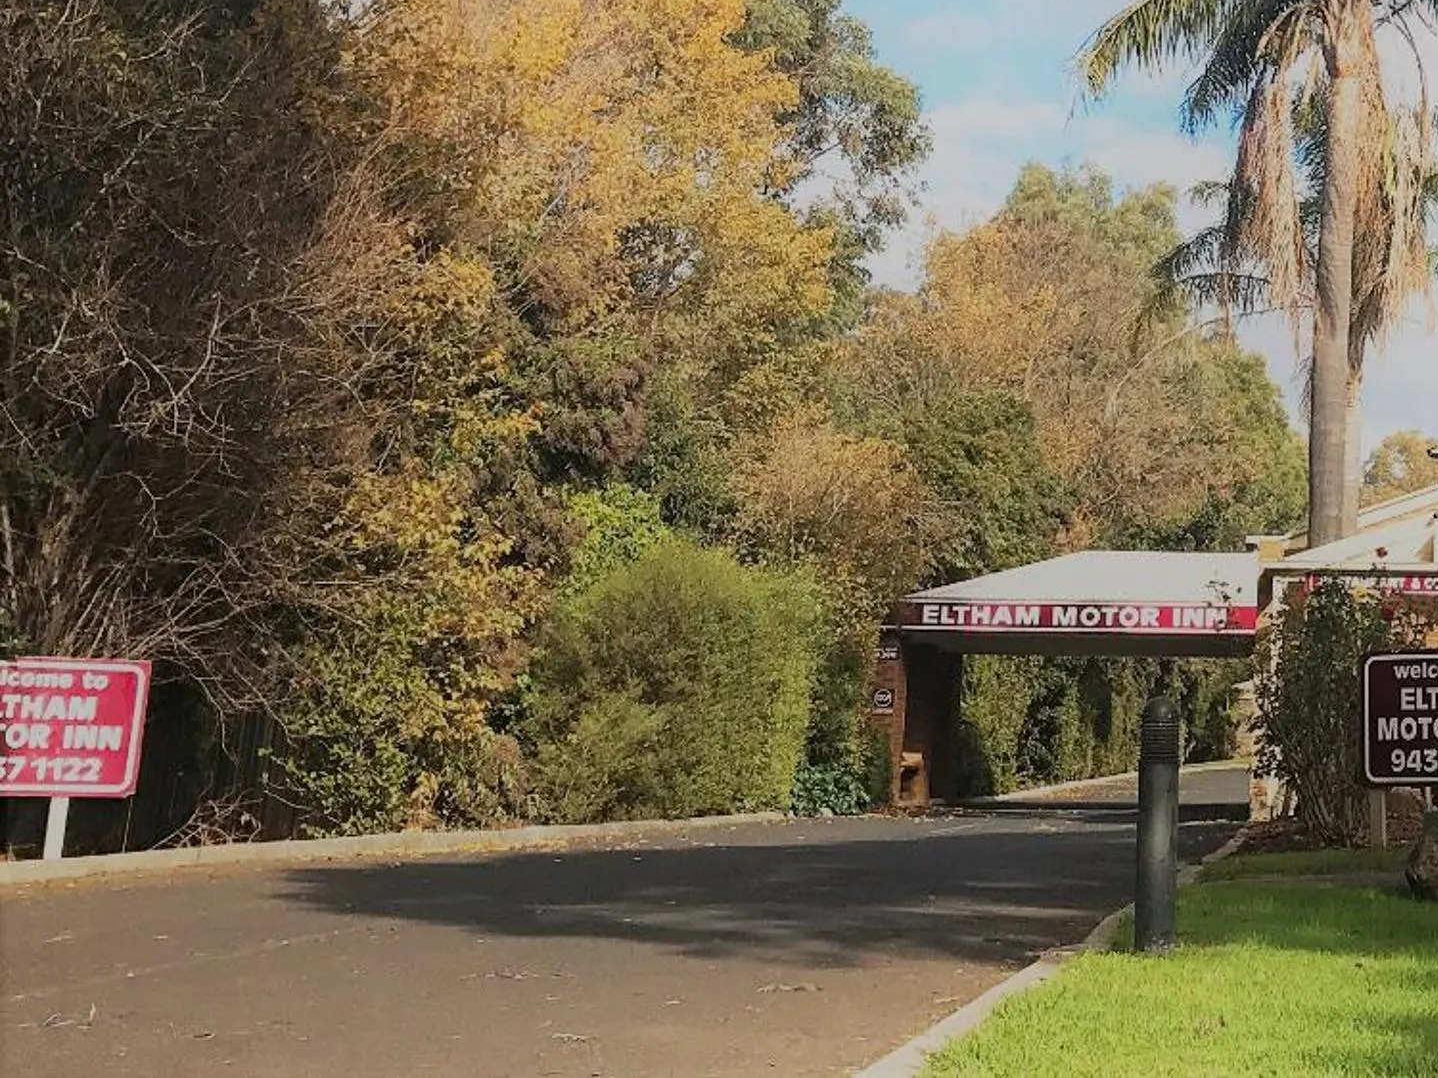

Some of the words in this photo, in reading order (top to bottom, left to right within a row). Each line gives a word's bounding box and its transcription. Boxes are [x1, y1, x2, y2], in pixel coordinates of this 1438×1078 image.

[921, 604, 1040, 627] ELTHAM
[1051, 606, 1160, 628] MOTOR
[1172, 607, 1228, 629] INN
[82, 672, 109, 691] to
[62, 725, 123, 751] INN
[31, 756, 103, 782] 1122
